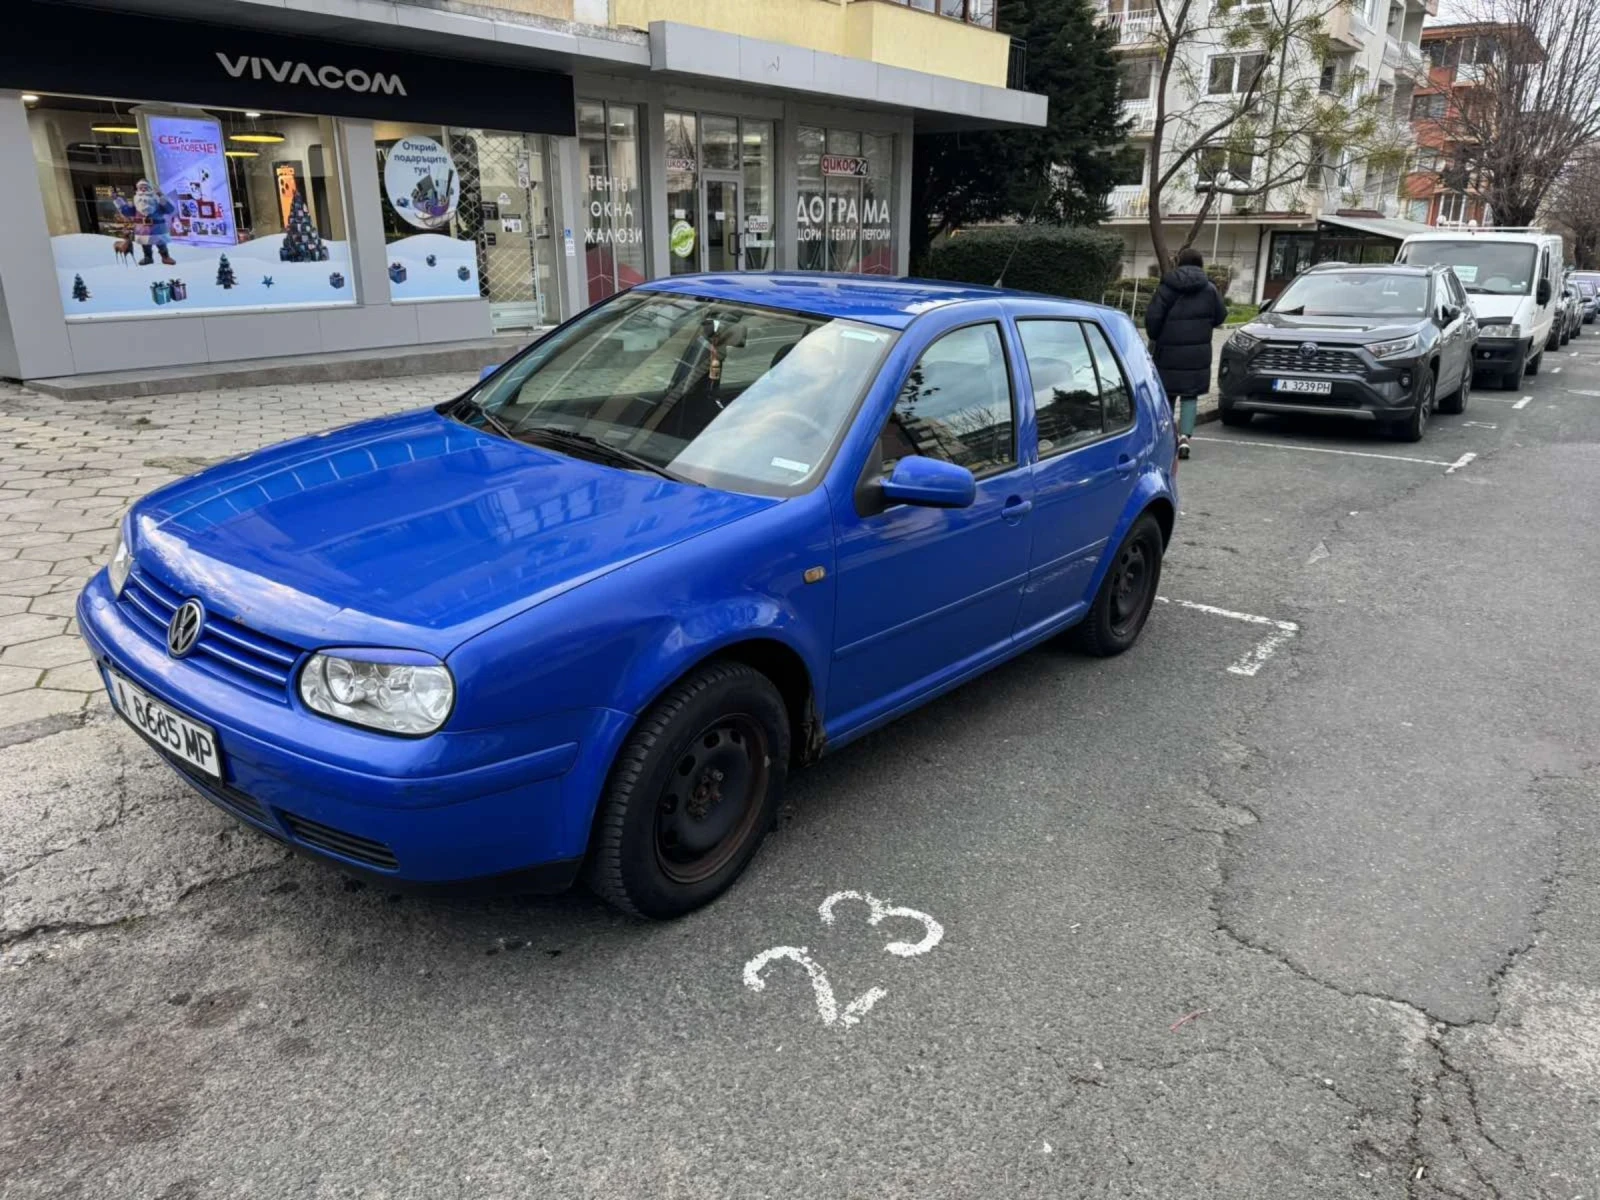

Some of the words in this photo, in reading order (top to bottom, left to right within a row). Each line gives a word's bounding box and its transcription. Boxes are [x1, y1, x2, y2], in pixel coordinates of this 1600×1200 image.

[216, 52, 408, 96] VIVACOM
[159, 134, 184, 145] СЕГА
[402, 141, 437, 152] Открий
[394, 153, 448, 164] подаръците
[413, 165, 431, 176] тук!
[591, 201, 633, 217] ОКНА
[797, 196, 890, 226] ДОГРАМА
[584, 227, 643, 244] ЖАЛЮЗИ
[831, 228, 857, 241] ТЕНТИ
[1292, 381, 1316, 392] 3239
[1317, 383, 1331, 393] PH
[133, 695, 181, 750] 8685
[182, 723, 212, 765] MP
